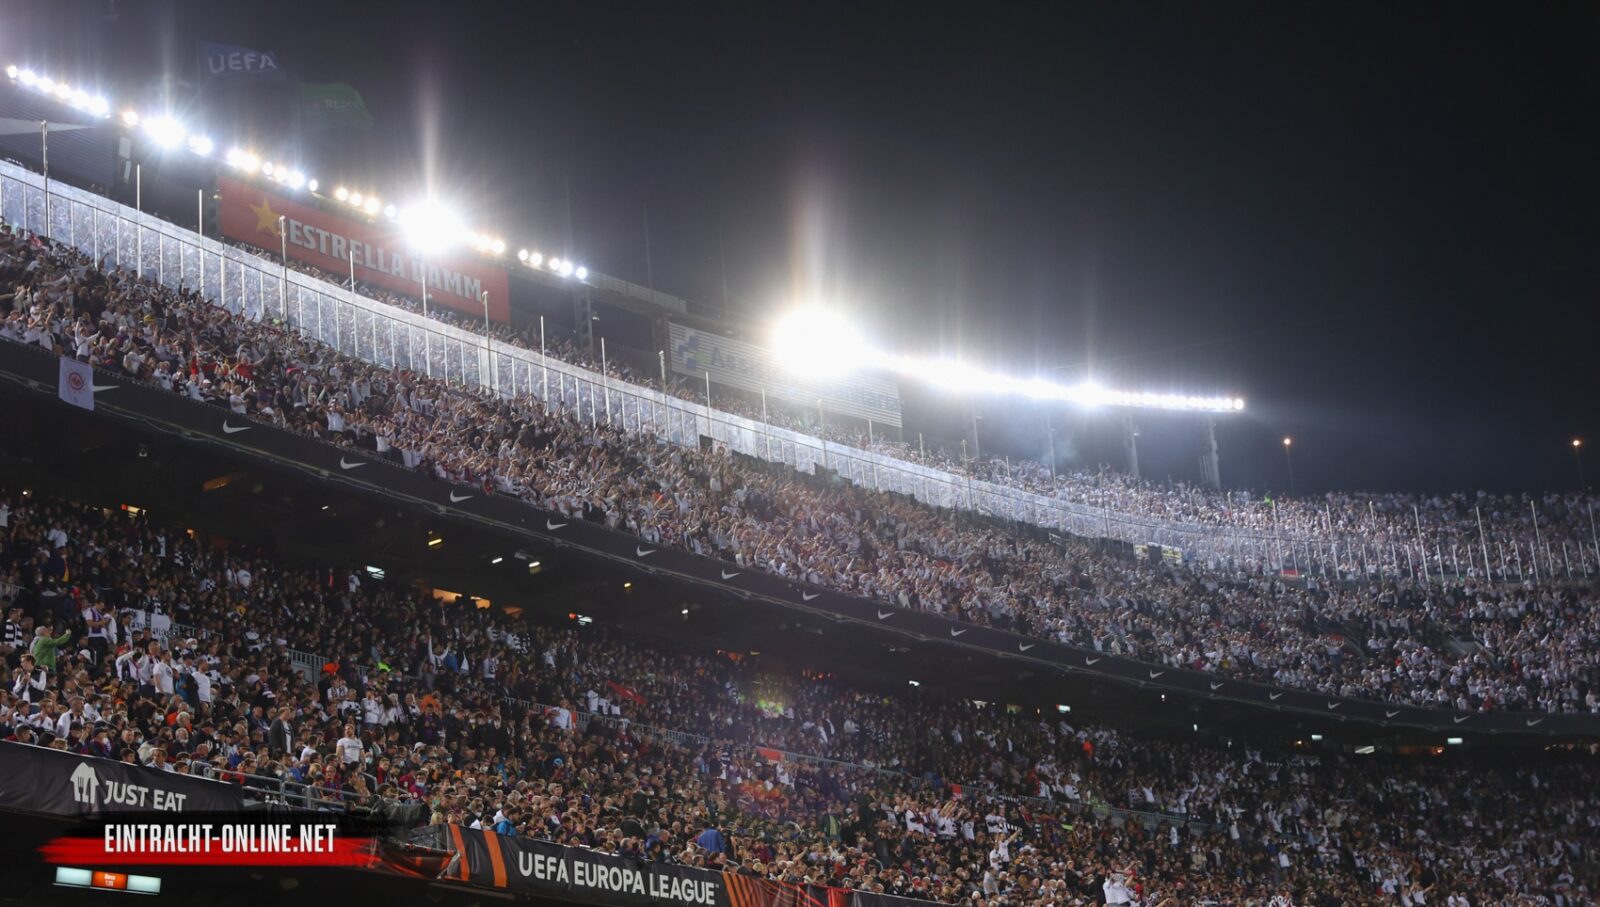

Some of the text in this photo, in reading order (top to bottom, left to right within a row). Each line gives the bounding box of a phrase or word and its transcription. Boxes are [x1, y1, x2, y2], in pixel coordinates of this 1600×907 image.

[208, 52, 277, 74] UEFA
[288, 219, 482, 302] ESTRELLA DAMM
[104, 780, 187, 812] JUST EAT
[518, 850, 570, 884] UEFA
[573, 860, 646, 895] EUROPA
